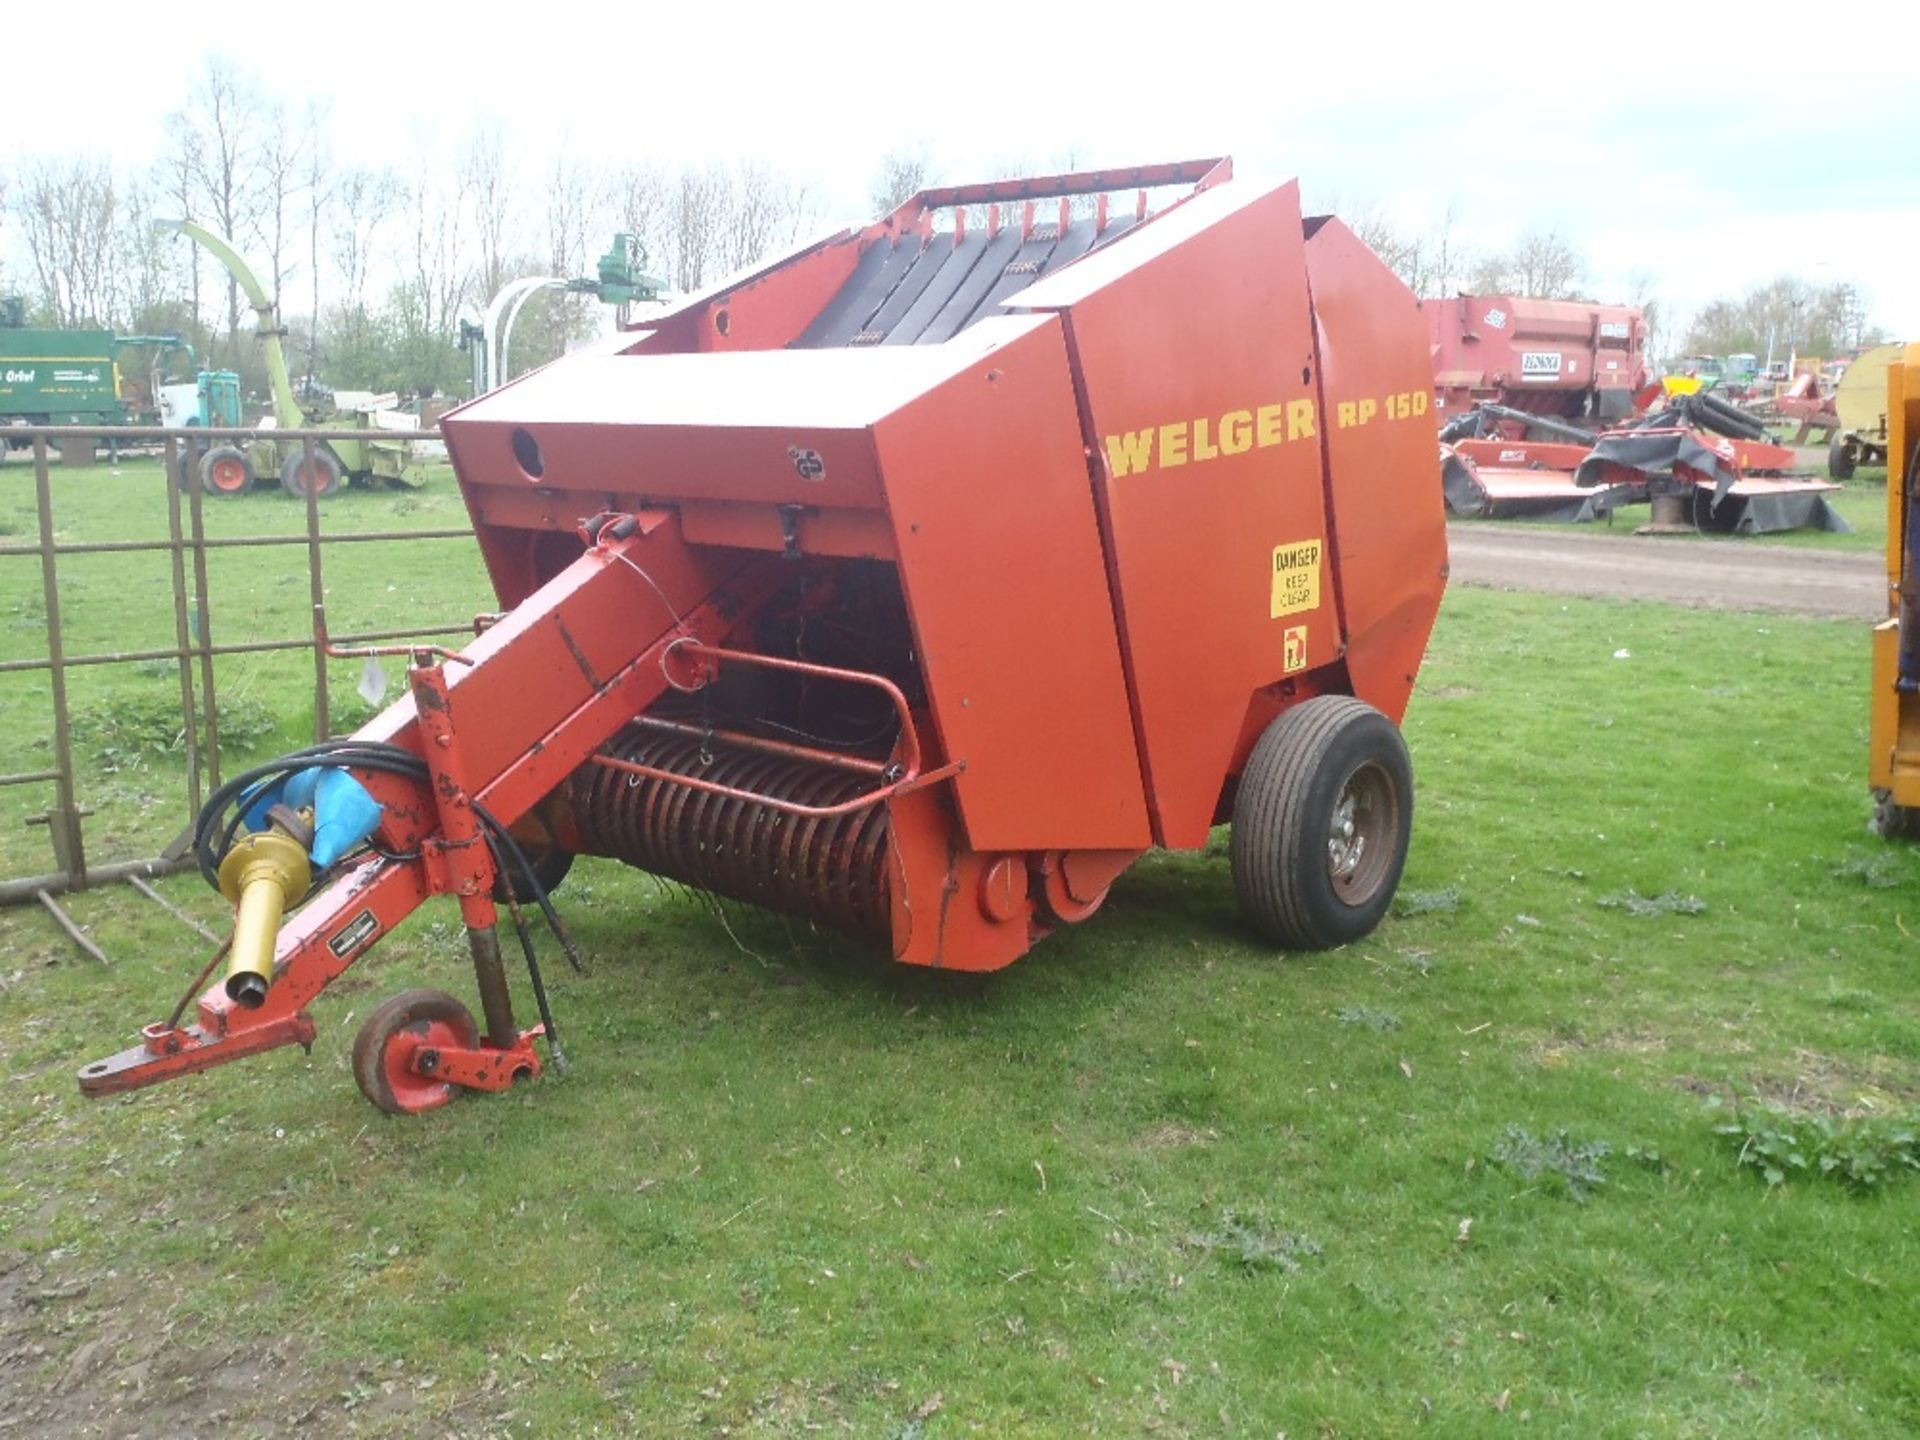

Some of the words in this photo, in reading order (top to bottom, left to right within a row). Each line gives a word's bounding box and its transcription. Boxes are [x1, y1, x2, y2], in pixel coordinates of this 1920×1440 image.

[1106, 398, 1316, 478] WELGER
[1338, 398, 1378, 429] RP
[1386, 391, 1427, 420] 150
[1276, 546, 1318, 572] DANGER
[1286, 573, 1308, 589] KEEP
[1280, 589, 1311, 608] CLEAR
